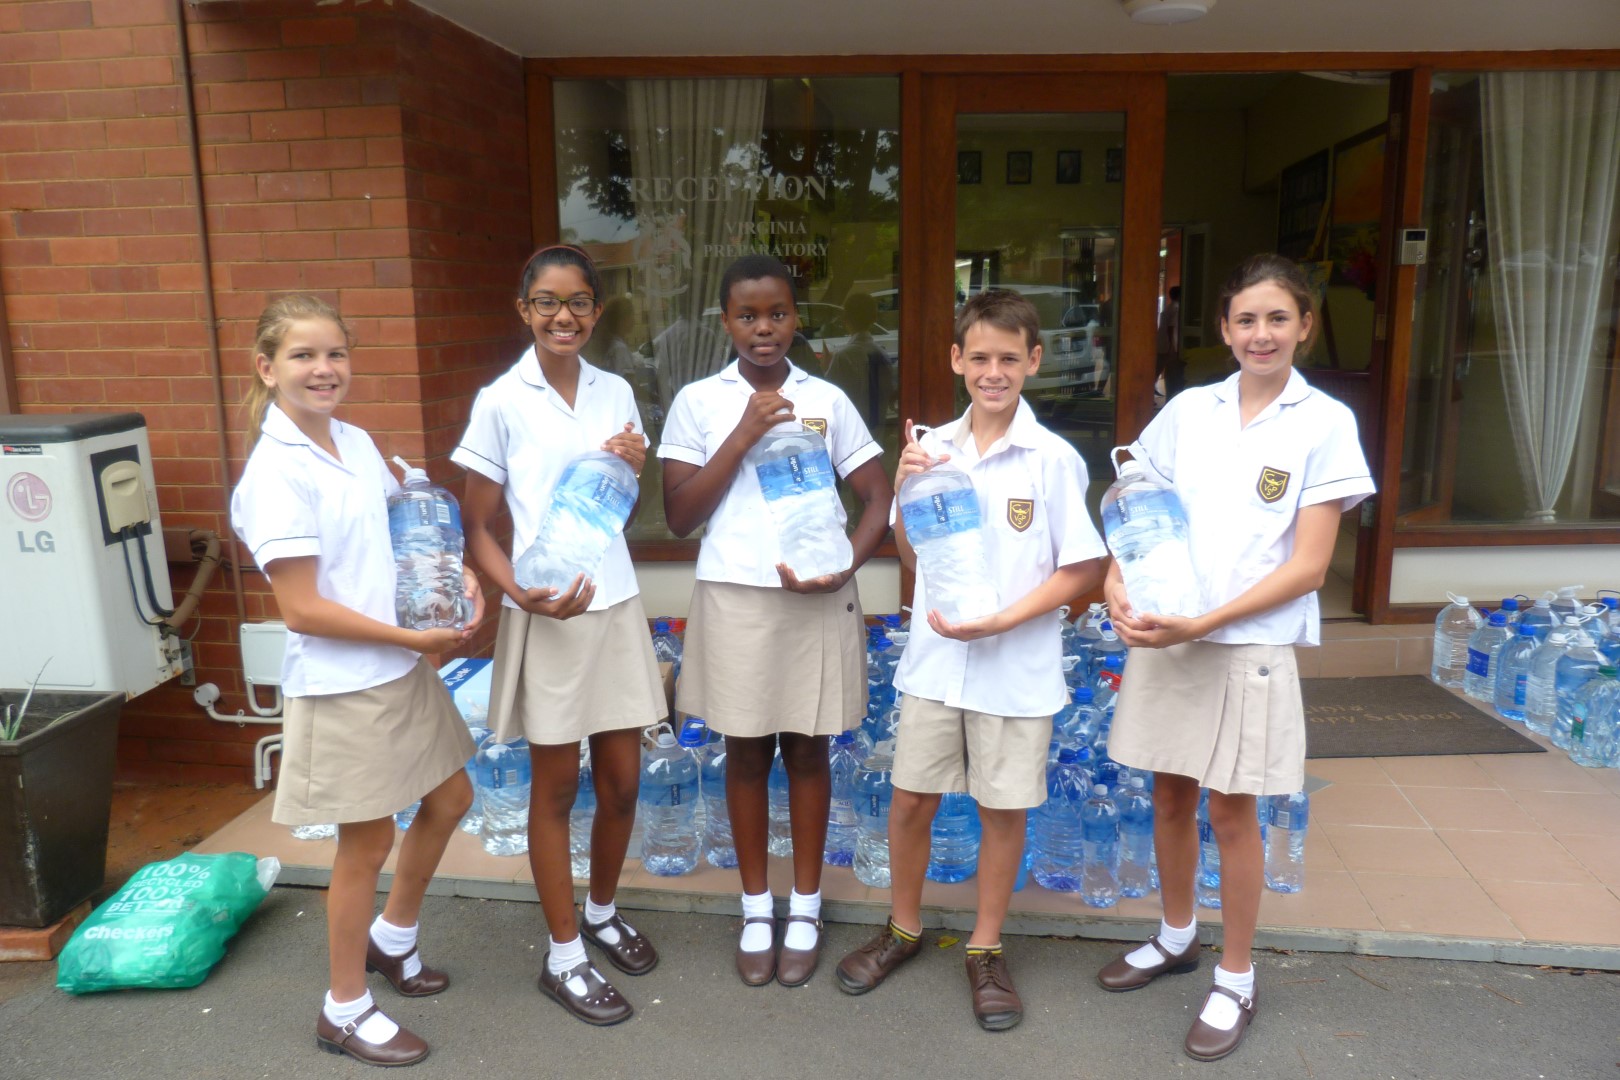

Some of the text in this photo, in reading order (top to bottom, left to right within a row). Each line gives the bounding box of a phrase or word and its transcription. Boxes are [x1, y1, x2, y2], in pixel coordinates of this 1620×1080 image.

[630, 175, 828, 201] RECEPTION
[725, 221, 807, 235] VIRGINIA
[703, 242, 829, 257] PREPARATORY
[17, 531, 56, 553] LG
[1363, 711, 1462, 722] School
[141, 863, 211, 879] 100%
[130, 878, 204, 889] RECYCLED
